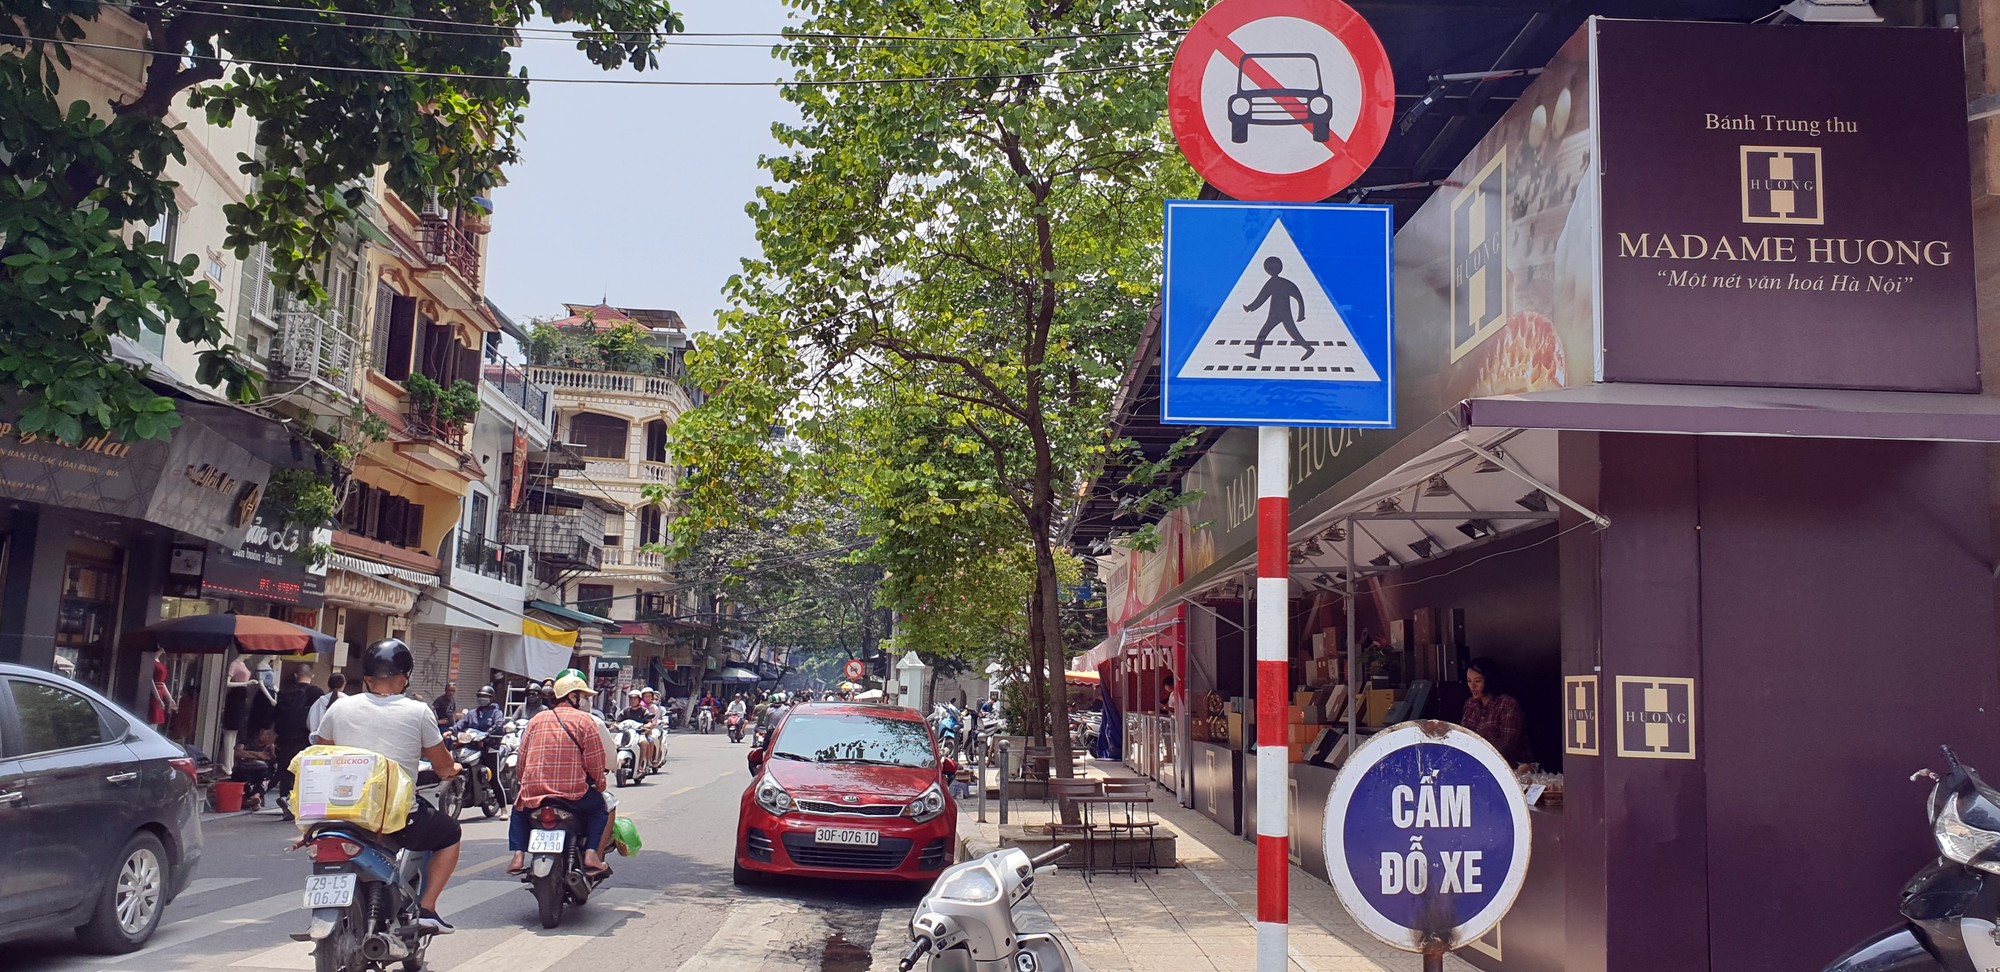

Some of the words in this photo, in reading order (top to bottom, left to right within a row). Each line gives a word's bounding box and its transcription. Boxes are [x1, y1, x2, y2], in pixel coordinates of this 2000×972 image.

[1704, 112, 1756, 131] Bánh
[1761, 114, 1821, 137] Trung
[1826, 116, 1858, 133] thu
[1750, 178, 1814, 192] HUONG
[1456, 230, 1500, 288] HUONG
[1617, 231, 1798, 263] MADAME
[1806, 237, 1953, 267] HUONG
[1712, 273, 1742, 290] nét
[1747, 274, 1782, 291] văn
[1787, 273, 1824, 291] hoá
[1831, 274, 1860, 293] Hà
[1568, 710, 1595, 721] HUONG
[1625, 711, 1687, 724] HUONG
[1391, 769, 1472, 828] CẤM
[1380, 835, 1428, 895] ĐỖ
[1439, 850, 1483, 894] XE
[311, 876, 348, 891] 29-L5
[307, 890, 350, 906] 106.79
